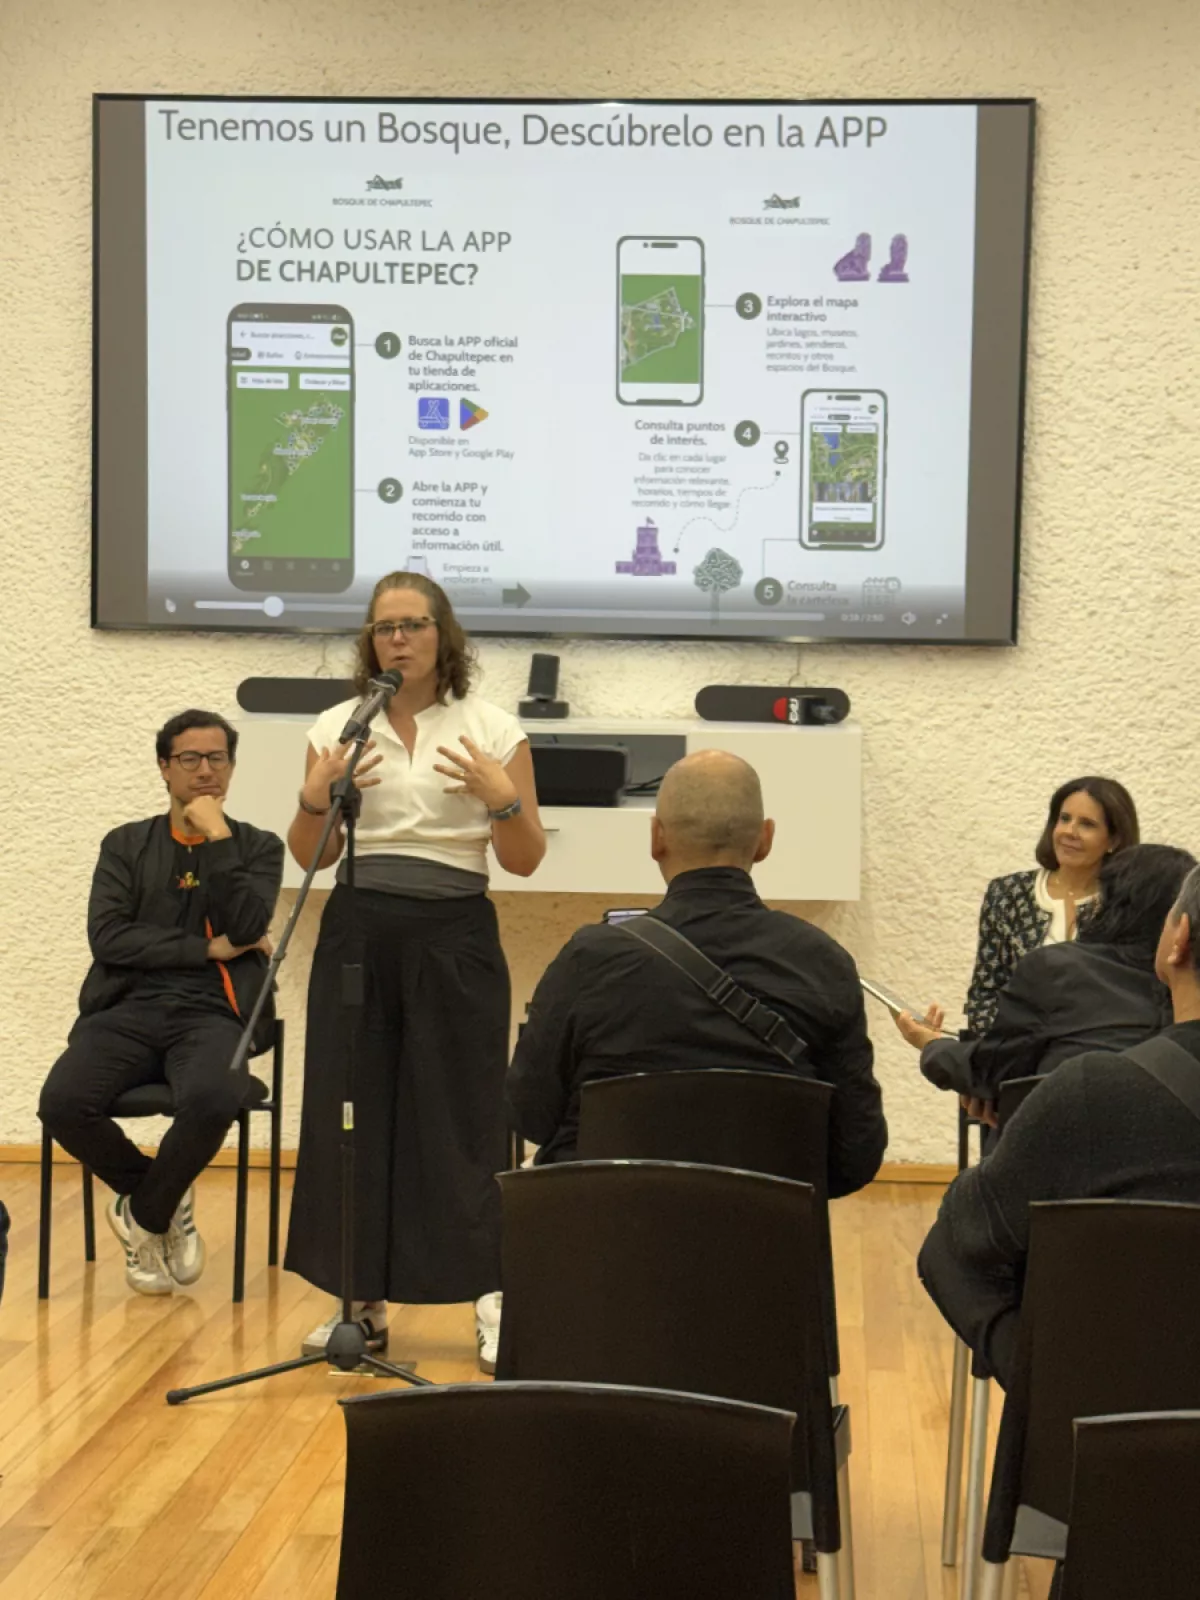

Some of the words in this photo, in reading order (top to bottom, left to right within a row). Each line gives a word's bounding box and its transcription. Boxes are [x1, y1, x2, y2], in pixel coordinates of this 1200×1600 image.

[158, 109, 313, 142] Tenemos
[324, 119, 366, 143] un
[378, 112, 511, 154] Bosque,
[522, 114, 713, 147] Descúbrelo
[723, 124, 765, 148] en
[777, 113, 805, 148] la
[814, 116, 888, 148] APP
[332, 198, 365, 206] BOSQUE
[379, 199, 432, 207] CHAPULTEPEC
[729, 217, 762, 225] BOSQUE
[764, 217, 775, 225] DE
[236, 222, 334, 253] ¿CÓMO
[343, 229, 411, 251] USAR
[421, 230, 454, 251] LA
[463, 231, 512, 252] APP
[236, 259, 271, 281] DE
[279, 259, 479, 285] CHAPULTEPEC?
[743, 300, 754, 313] 3
[767, 296, 810, 309] Explora
[812, 296, 824, 307] el
[826, 298, 859, 310] mapa
[766, 312, 828, 322] interactivo
[767, 327, 792, 337] Ubica
[383, 339, 392, 353] 1
[408, 335, 442, 346] Busca
[444, 335, 455, 346] la
[457, 336, 482, 347] APP
[484, 336, 518, 348] oficial
[408, 350, 423, 361] de
[425, 350, 496, 364] Chapultepec
[499, 354, 514, 363] en
[803, 354, 809, 362] y
[810, 352, 835, 360] otros
[408, 366, 420, 376] tu
[423, 365, 459, 376] tienda
[461, 365, 476, 377] de
[766, 364, 804, 374] espacios
[806, 363, 820, 372] del
[408, 380, 480, 393] aplicaciones.
[635, 419, 684, 431] Consulta
[686, 421, 726, 433] puntos
[741, 427, 753, 440] 4
[408, 436, 455, 447] Disponible
[650, 434, 664, 445] de
[667, 434, 708, 446] interés.
[408, 448, 427, 459] App
[428, 448, 453, 457] Store
[455, 451, 460, 460] y
[461, 448, 494, 460] Google
[496, 449, 515, 460] Play
[638, 452, 651, 462] Da
[653, 452, 667, 462] clic
[669, 454, 681, 462] en
[683, 453, 704, 462] cada
[705, 453, 727, 464] lugar
[654, 466, 674, 474] para
[675, 466, 711, 474] conocer
[385, 484, 396, 497] 2
[412, 481, 439, 492] Abre
[441, 481, 451, 492] la
[454, 482, 478, 493] APP
[480, 485, 488, 496] y
[715, 488, 727, 496] de
[412, 498, 467, 507] comienza
[469, 497, 481, 507] tu
[672, 501, 678, 509] y
[680, 499, 705, 508] cómo
[412, 511, 463, 522] recorrido
[465, 513, 486, 522] con
[412, 526, 450, 536] acceso
[452, 527, 459, 536] a
[412, 539, 480, 551] información
[482, 540, 503, 552] útil.
[443, 563, 481, 574] Empieza
[763, 584, 774, 599] 5
[787, 580, 837, 592] Consulta
